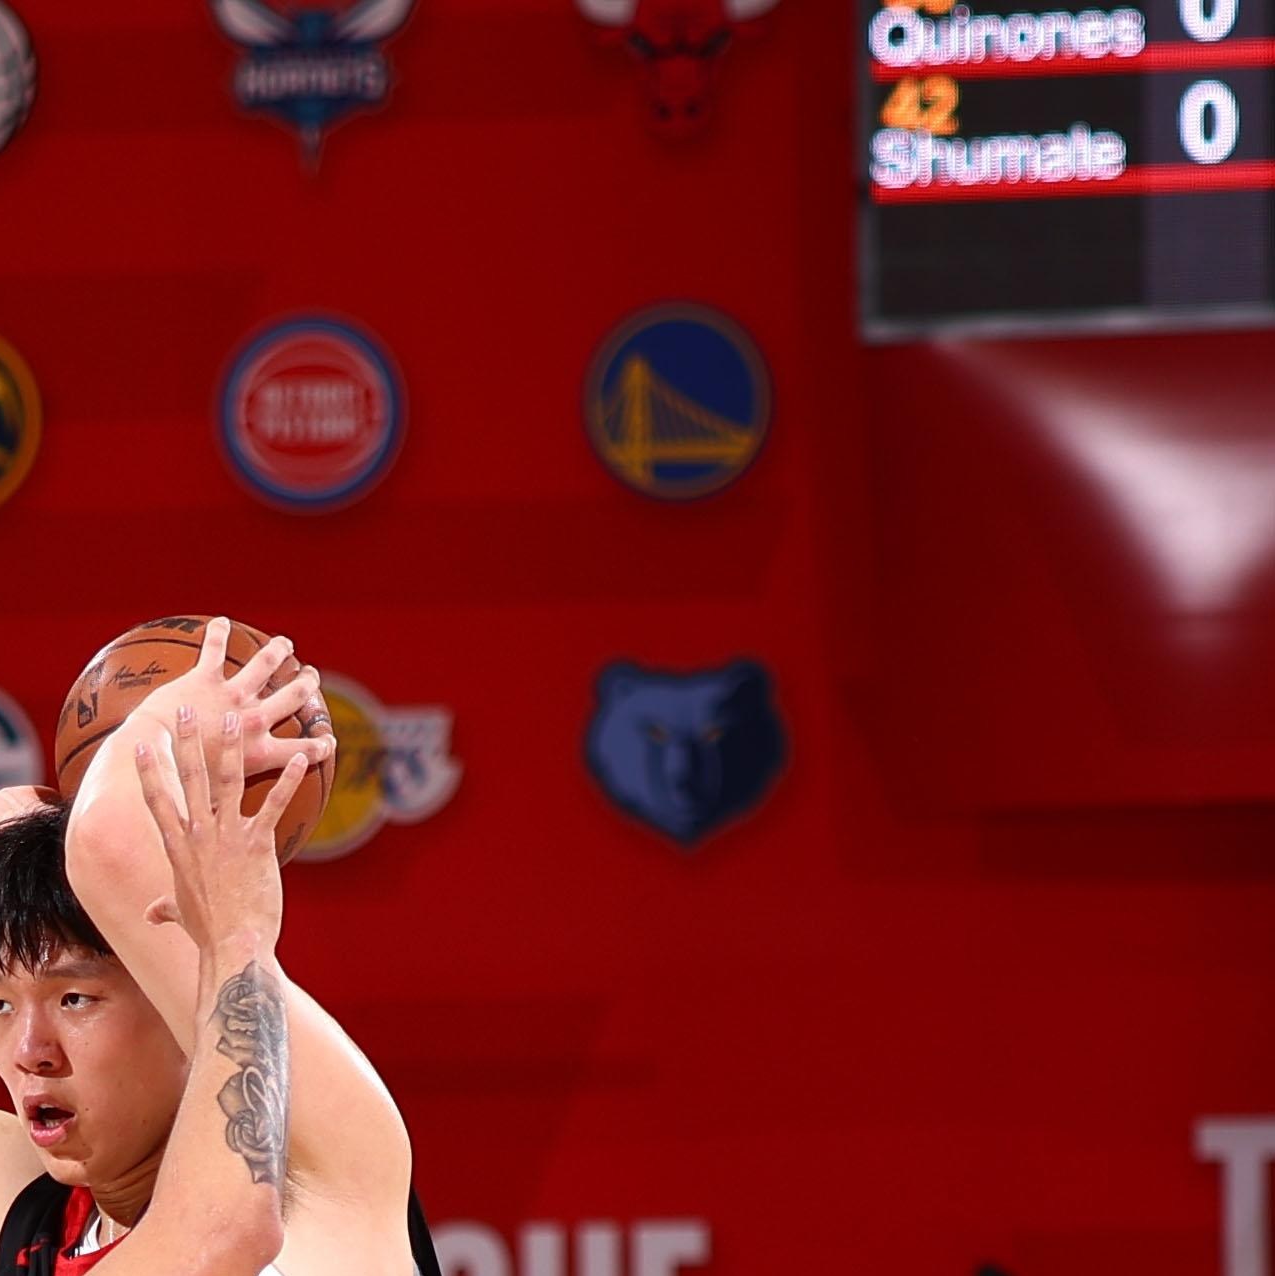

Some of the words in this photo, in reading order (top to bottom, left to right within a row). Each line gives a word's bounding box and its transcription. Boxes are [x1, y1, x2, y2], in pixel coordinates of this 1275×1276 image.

[869, 5, 1145, 67] Quinones
[879, 74, 959, 135] 42
[1179, 80, 1240, 164] 0
[870, 122, 1126, 189] Shumate
